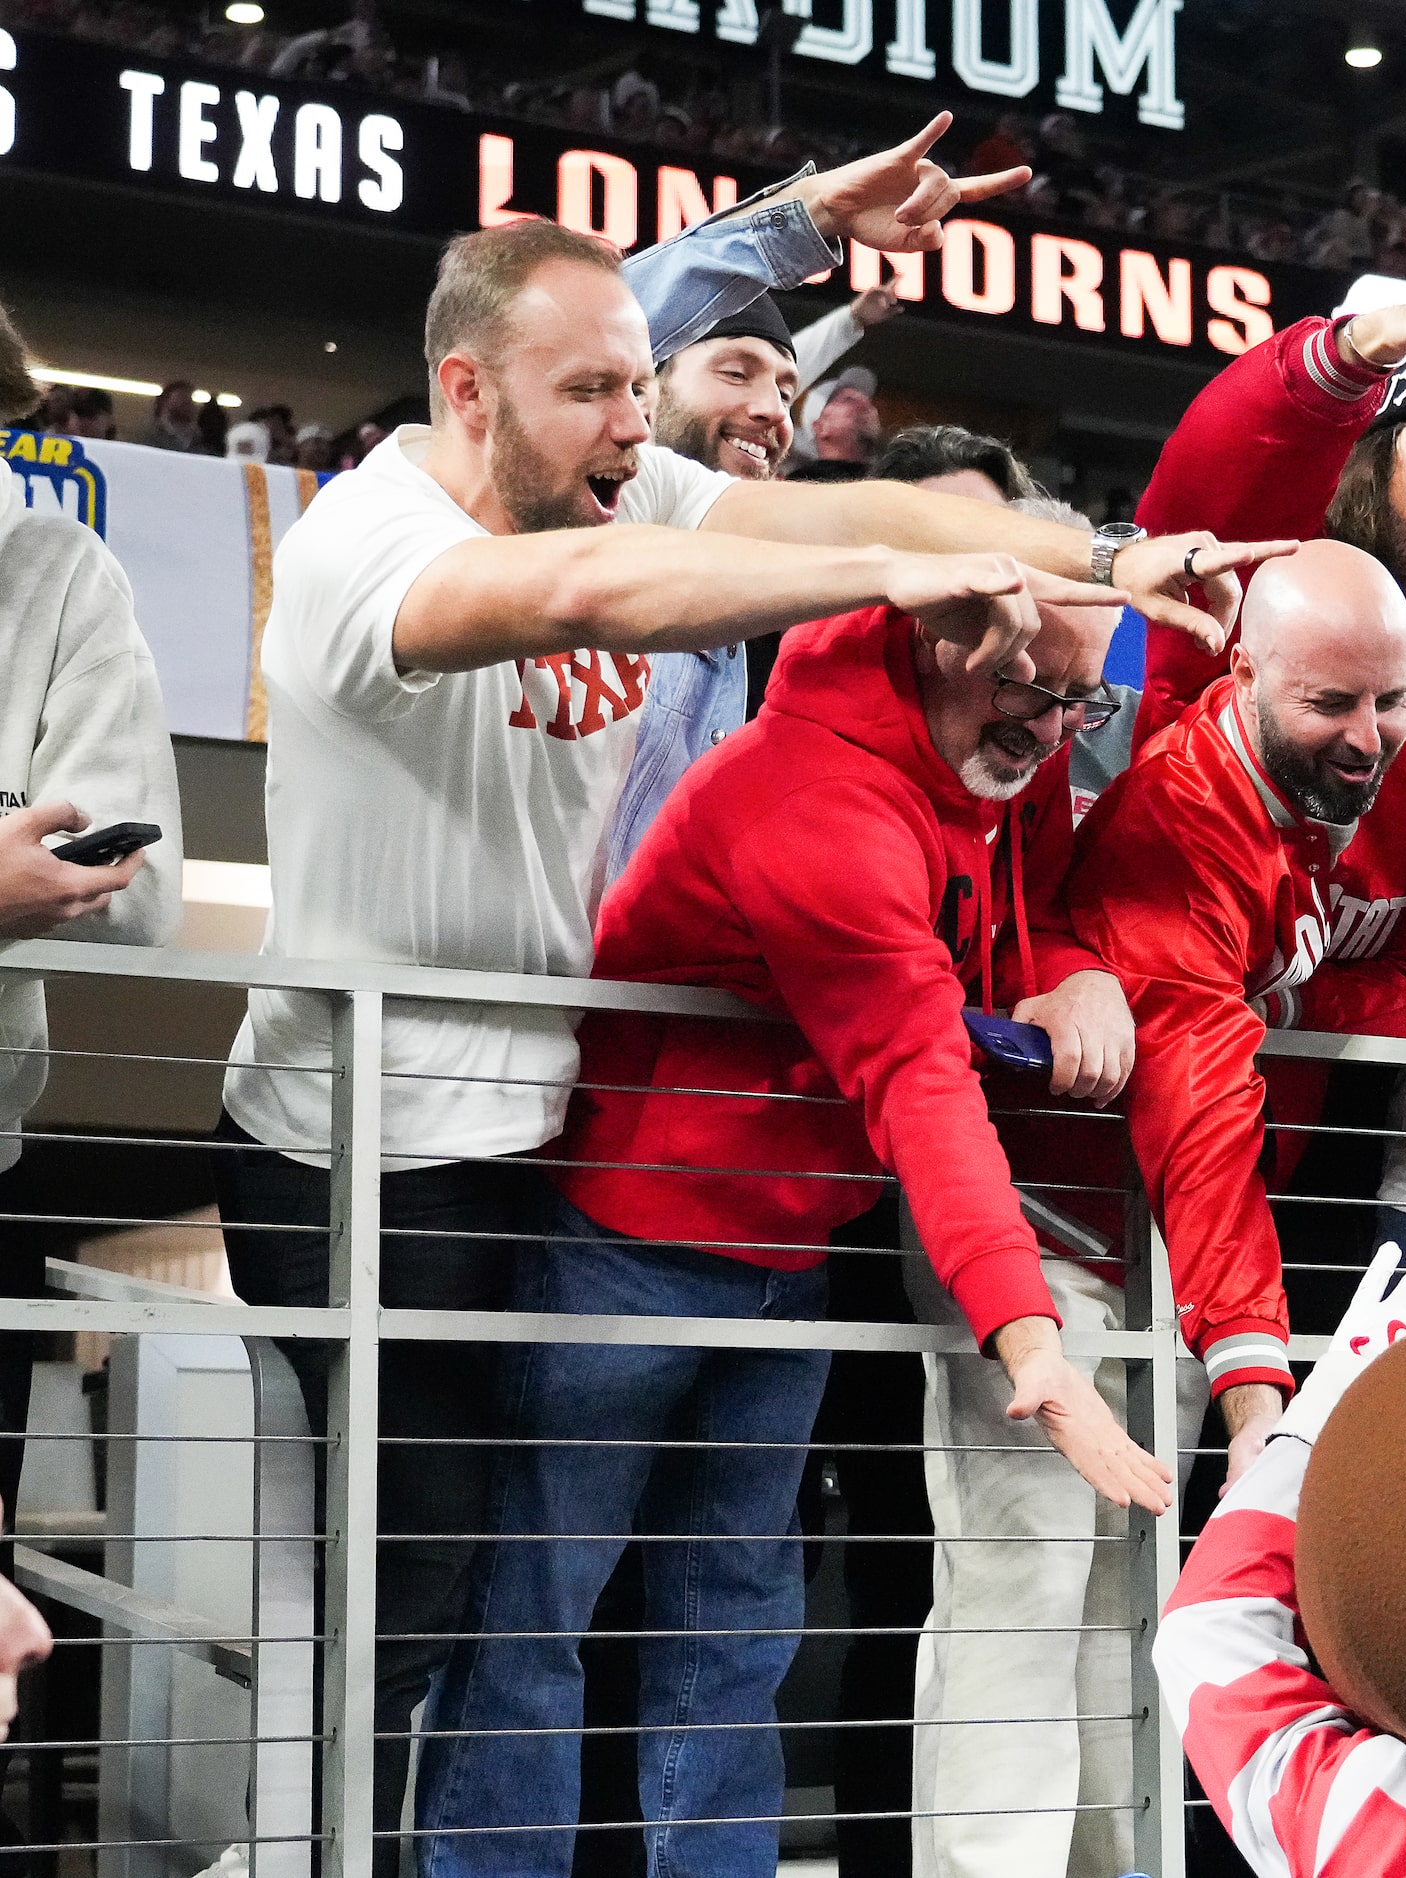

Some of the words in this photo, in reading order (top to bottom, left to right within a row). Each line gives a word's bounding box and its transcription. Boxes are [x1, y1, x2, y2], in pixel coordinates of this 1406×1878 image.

[583, 0, 1186, 129] DIUM
[119, 69, 404, 212] TEXAS
[479, 133, 1272, 355] LONHORNS
